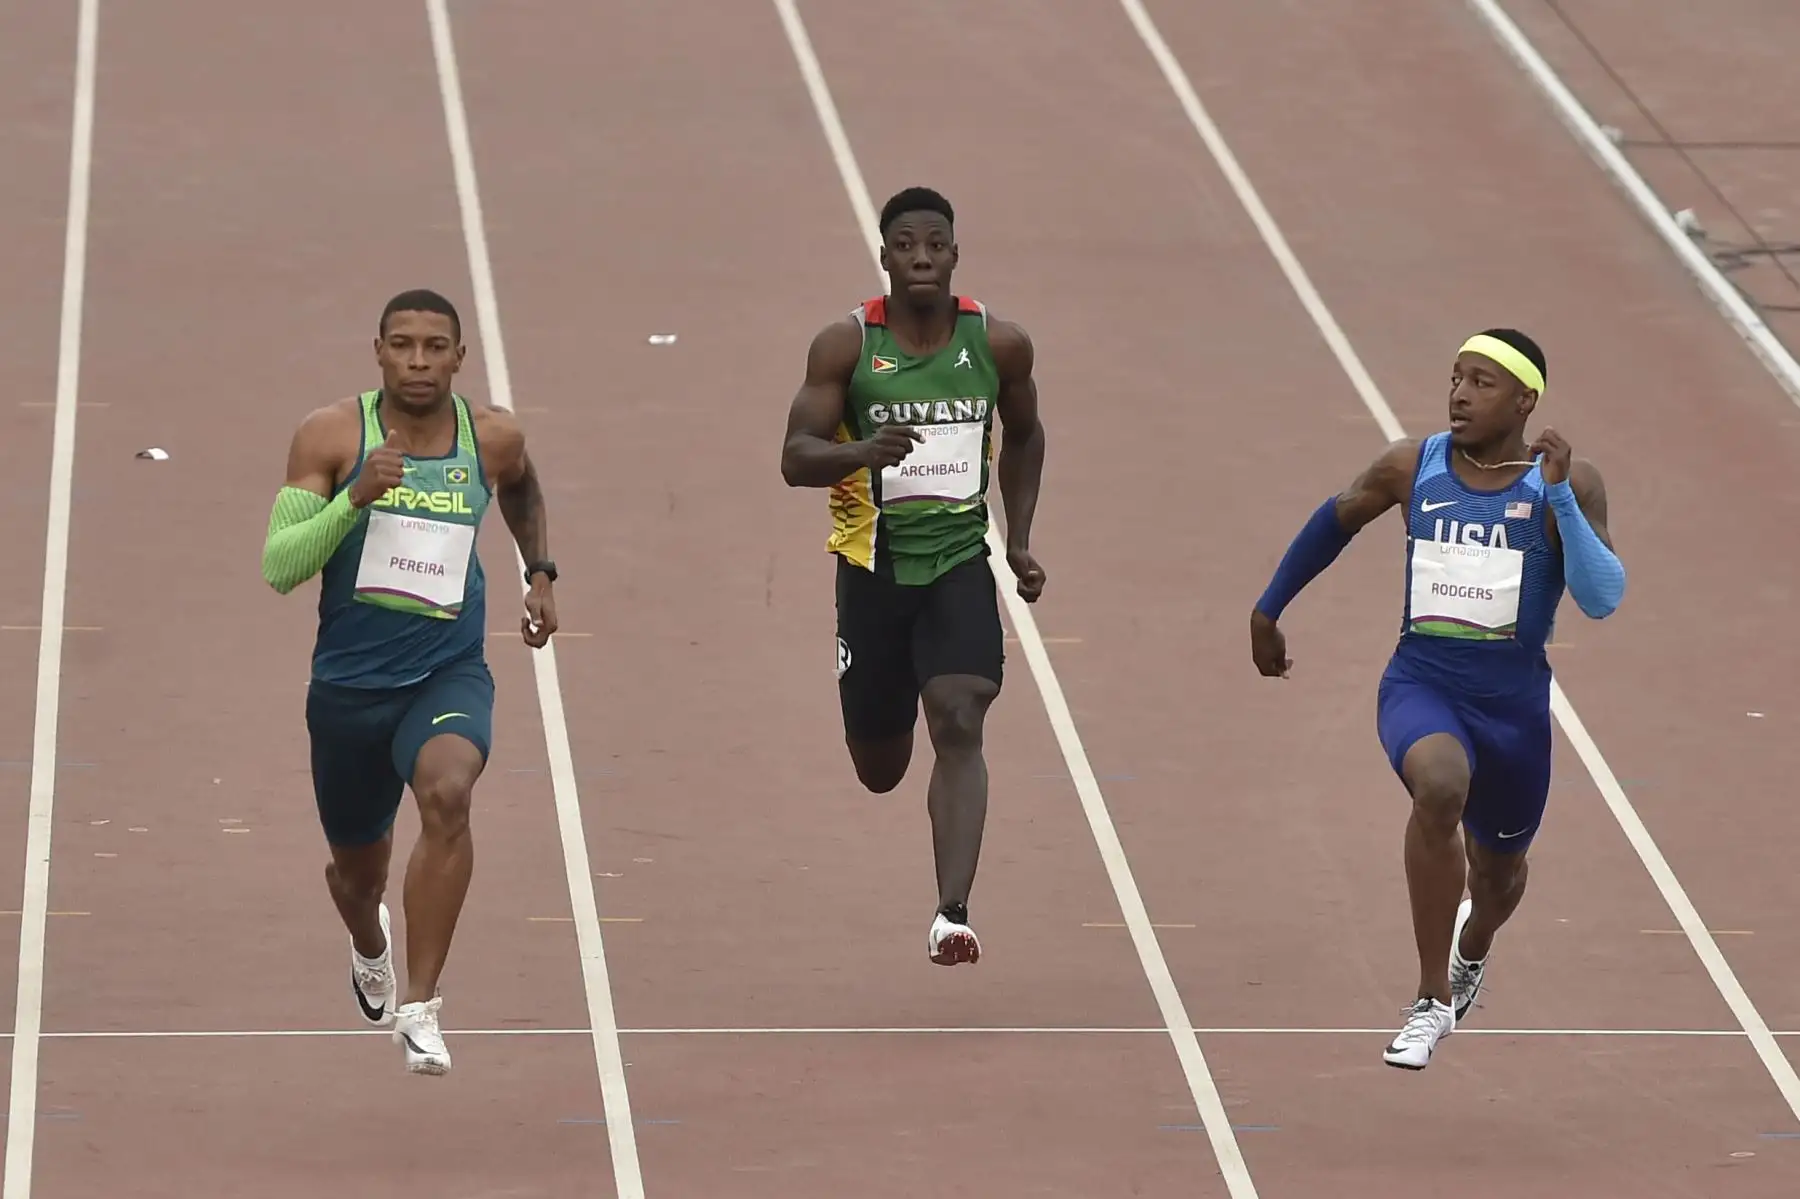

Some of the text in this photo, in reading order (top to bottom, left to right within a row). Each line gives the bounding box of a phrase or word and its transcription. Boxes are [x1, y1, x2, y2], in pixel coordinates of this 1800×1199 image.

[868, 398, 988, 424] GUYANA
[912, 426, 959, 437] ima2019
[900, 461, 968, 477] ARCHIBALD
[372, 486, 472, 514] BRASIL
[1434, 518, 1509, 550] USA
[389, 556, 445, 576] PEREIRA
[1431, 582, 1494, 601] RODGERS
